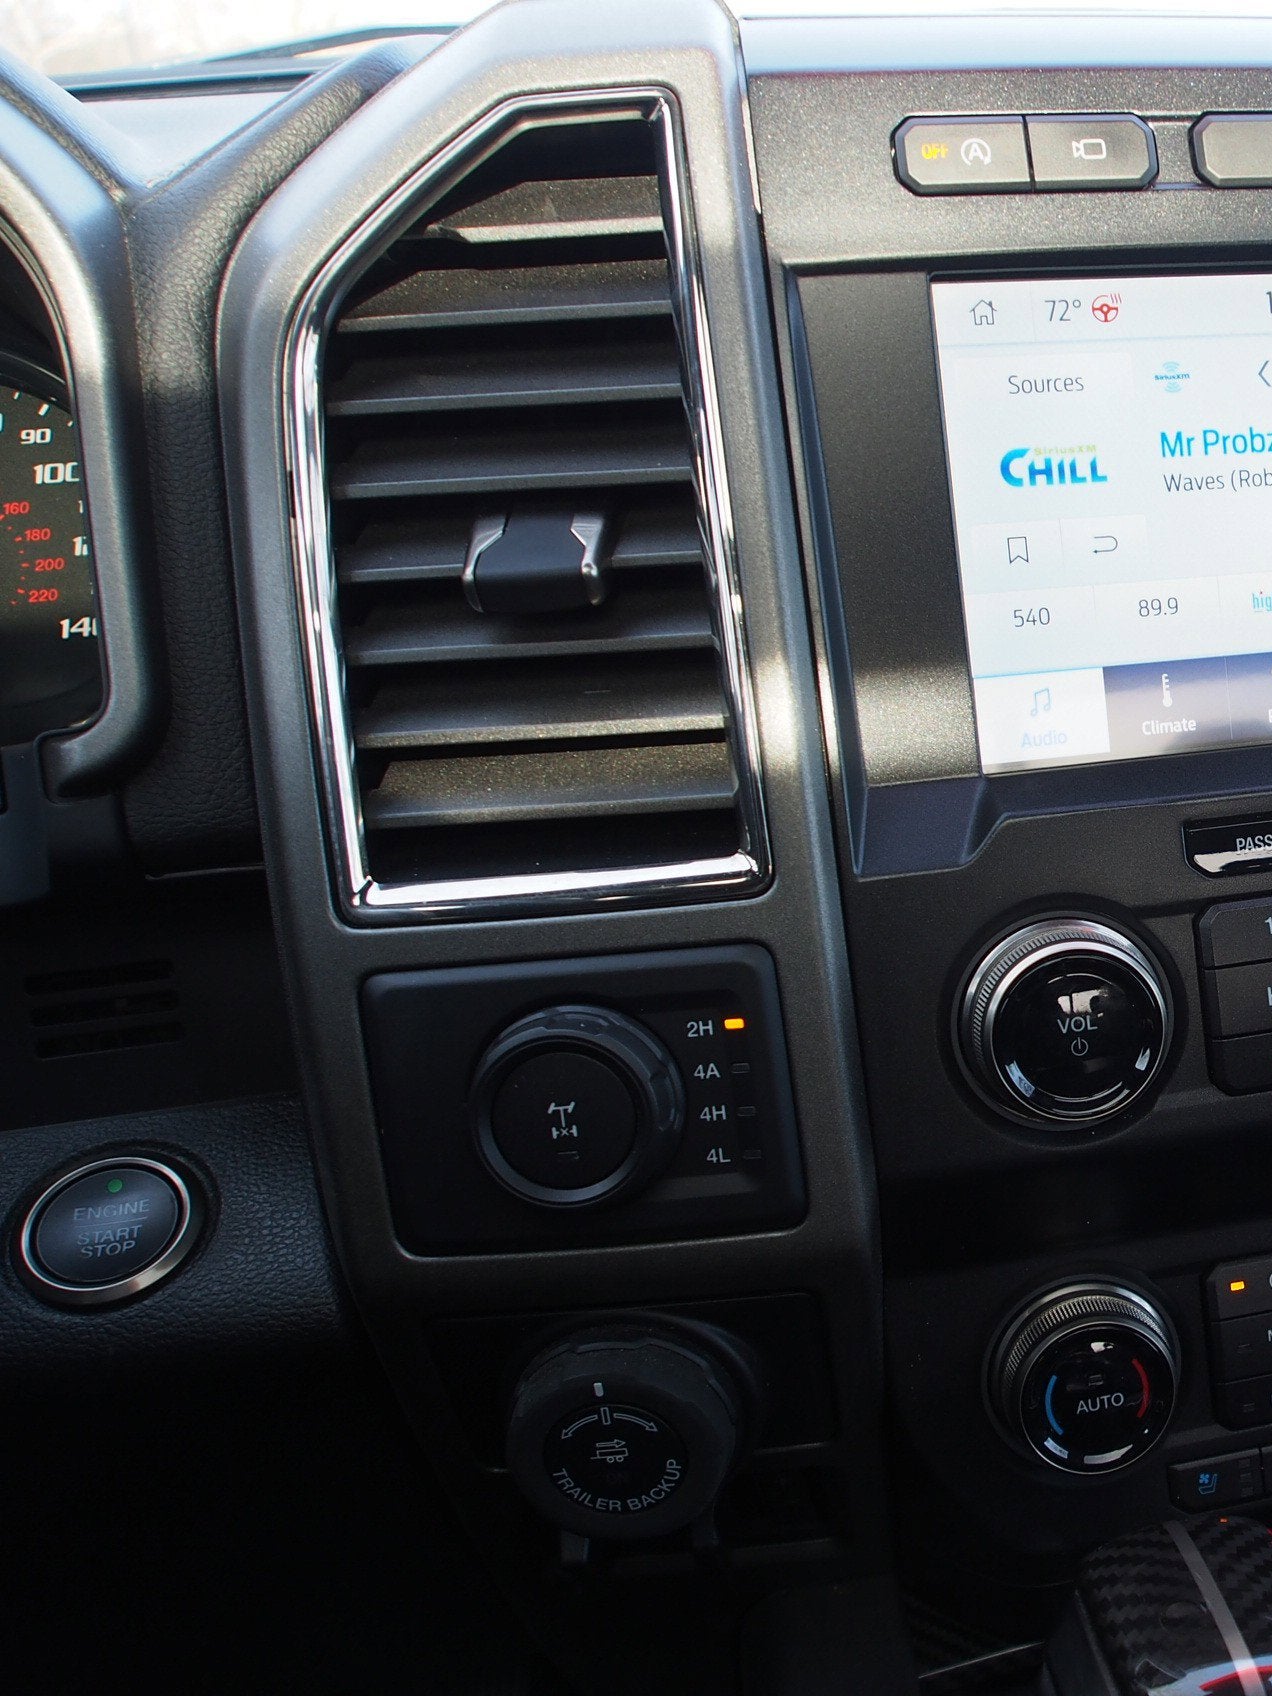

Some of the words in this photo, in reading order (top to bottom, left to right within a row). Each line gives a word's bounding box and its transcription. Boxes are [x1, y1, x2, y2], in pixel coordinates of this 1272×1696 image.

[1007, 374, 1085, 396] Sources
[20, 428, 52, 445] 90
[1160, 431, 1195, 458] Mr
[1163, 472, 1225, 493] Waves
[3, 501, 30, 515] 160
[25, 528, 51, 542] 180
[35, 557, 66, 572] 200
[28, 588, 59, 604] 220
[1138, 597, 1180, 618] 89.9
[1013, 607, 1051, 629] 540
[1142, 717, 1197, 737] Climate
[1021, 730, 1068, 749] Audio
[686, 1019, 715, 1039] 2H
[1057, 1015, 1099, 1034] VOL
[693, 1063, 722, 1080] 4A
[700, 1105, 727, 1122] 4H
[706, 1147, 732, 1164] 4L
[73, 1199, 151, 1221] ENGINE
[77, 1224, 143, 1246] START
[80, 1240, 136, 1260] STOP
[1076, 1392, 1125, 1415] AUTO
[552, 1467, 622, 1512] TRAILER
[626, 1458, 682, 1512] BACKUP
